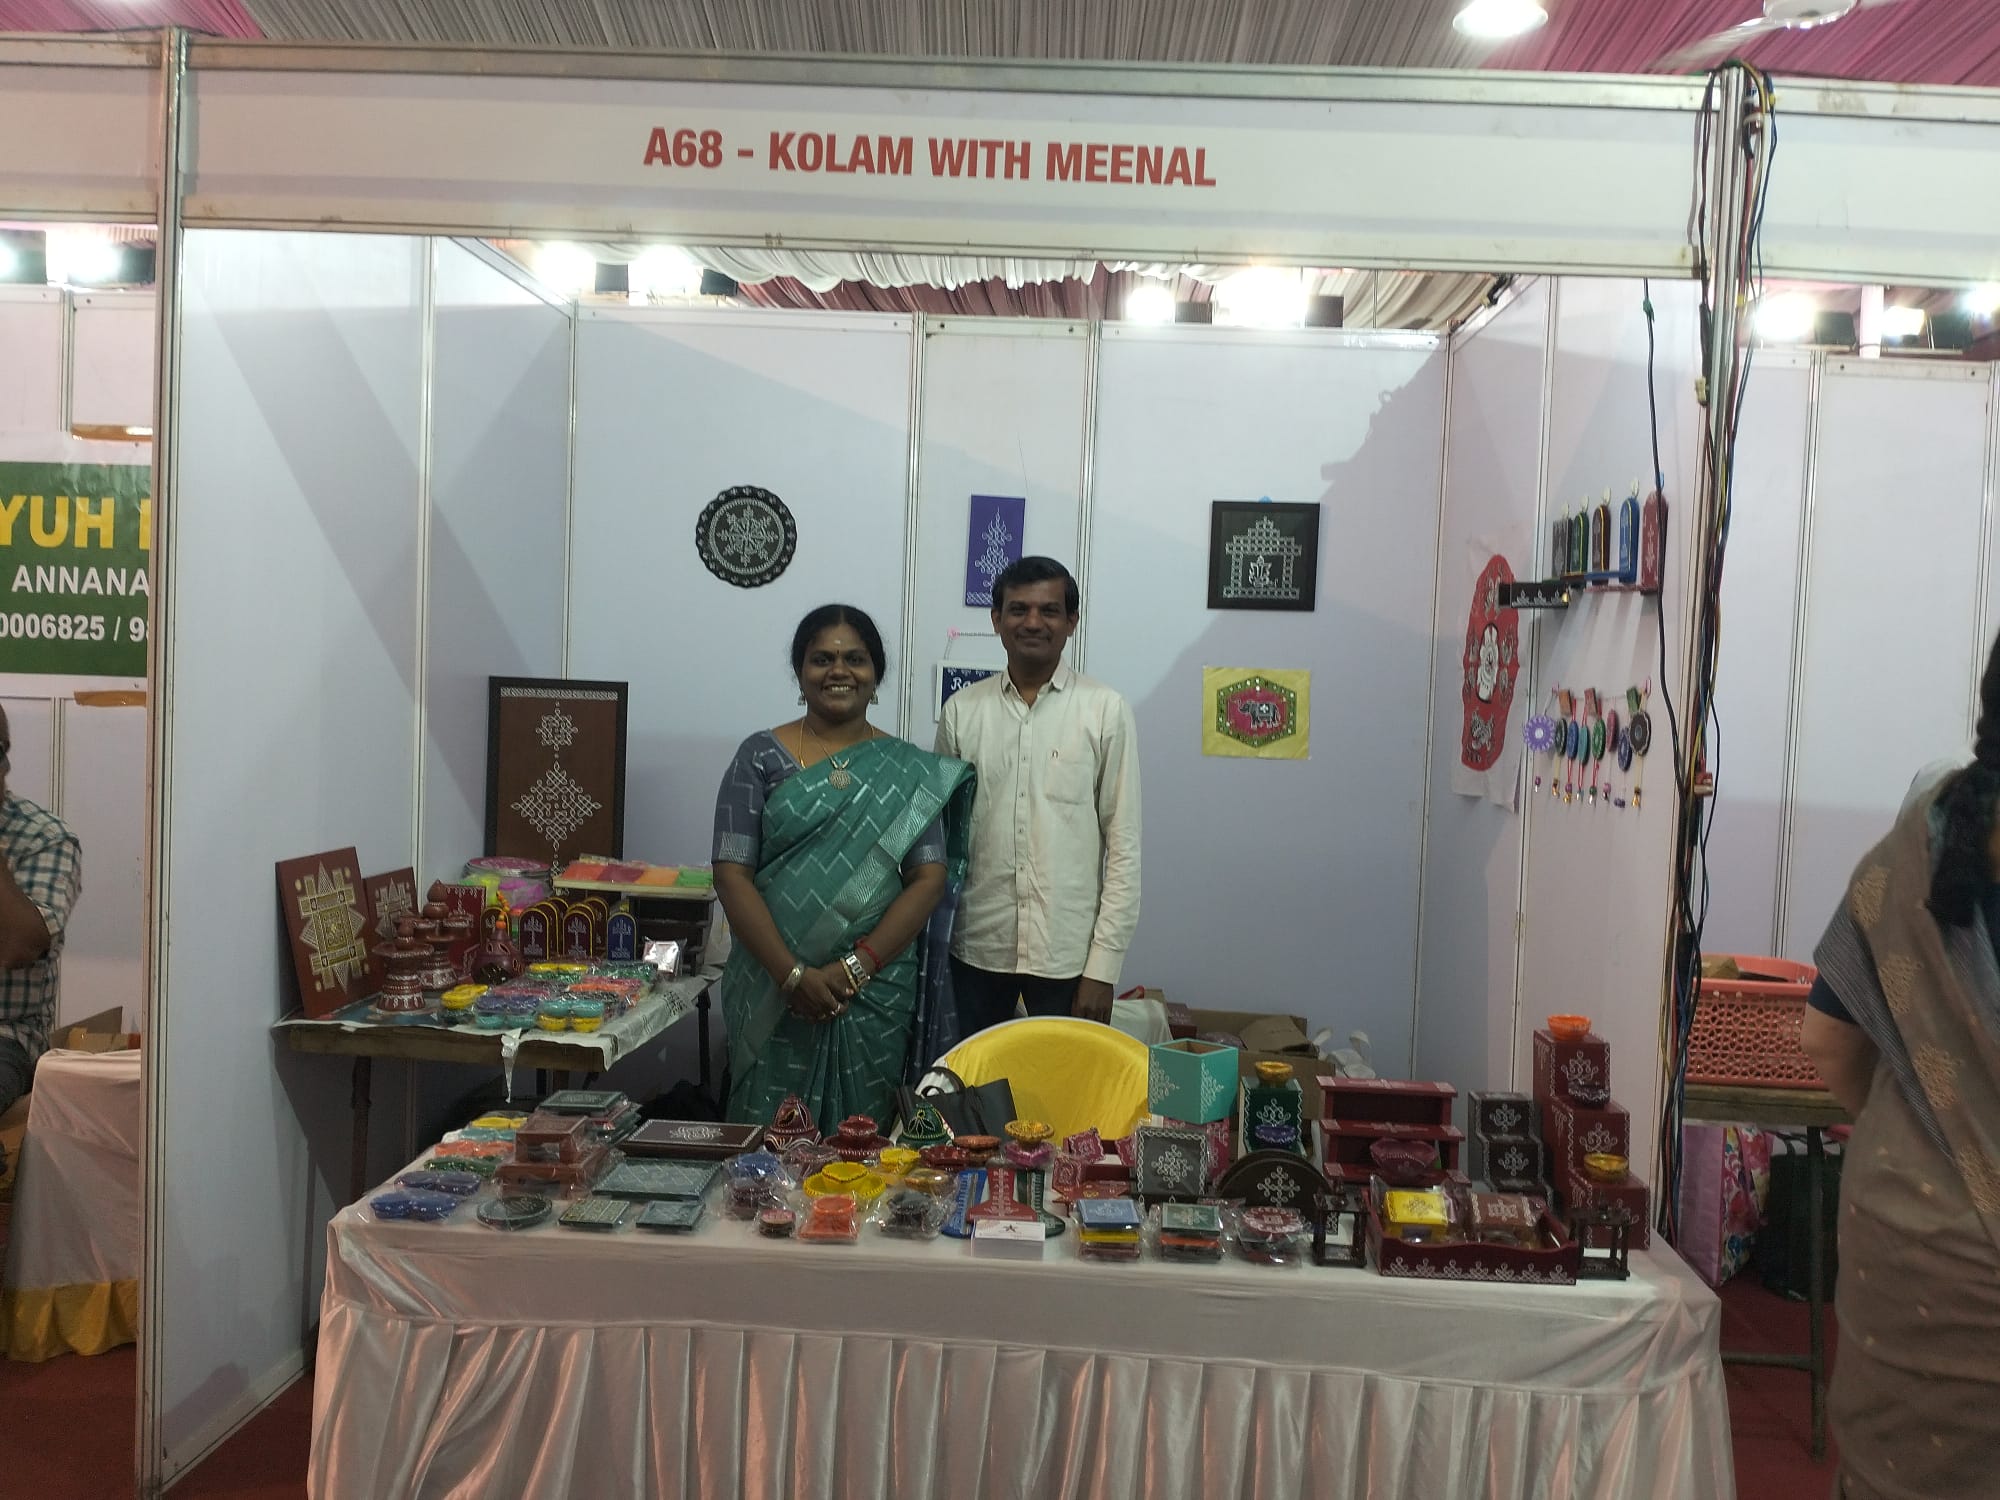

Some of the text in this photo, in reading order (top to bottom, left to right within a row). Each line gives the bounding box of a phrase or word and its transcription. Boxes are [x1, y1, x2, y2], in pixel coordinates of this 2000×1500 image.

[643, 126, 1217, 187] A68 - KOLAM WITH MEENAL
[11, 564, 149, 597] ANNANA
[129, 616, 148, 642] 9
